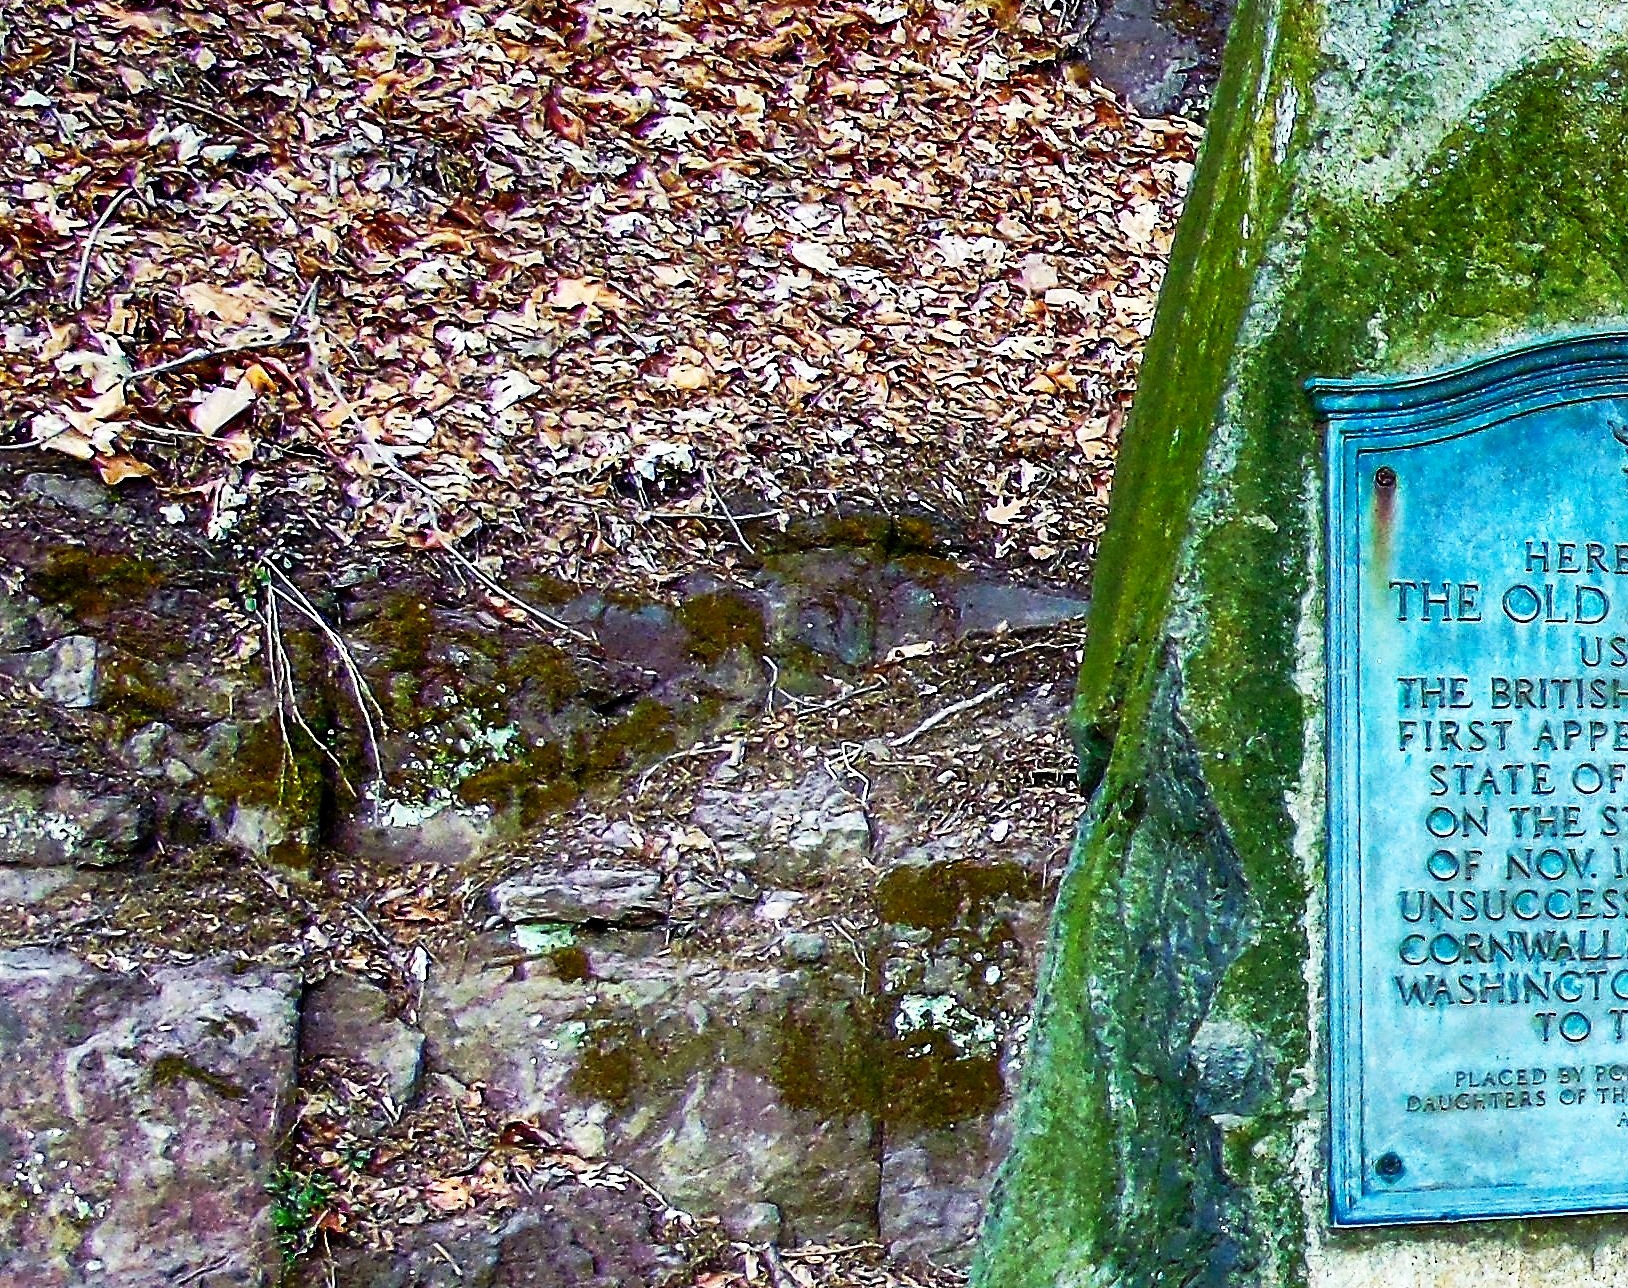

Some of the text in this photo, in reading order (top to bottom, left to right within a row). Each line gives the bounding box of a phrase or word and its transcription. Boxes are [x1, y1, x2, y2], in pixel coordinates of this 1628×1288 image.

[1389, 580, 1482, 622] THE
[1502, 584, 1610, 624] OLD
[1397, 677, 1473, 709] THE
[1398, 719, 1513, 752] FIRST
[1429, 763, 1556, 797] STATE
[1572, 762, 1626, 795] OF
[1426, 806, 1489, 839] ON
[1508, 806, 1587, 838] THE
[1426, 848, 1483, 881] OF
[1506, 848, 1597, 881] NOV.
[1535, 1010, 1592, 1043] TO
[1455, 1067, 1547, 1088] PLACED
[1557, 1065, 1585, 1084] BY
[1406, 1090, 1547, 1112] DAUGHTERS
[1559, 1088, 1586, 1105] OF
